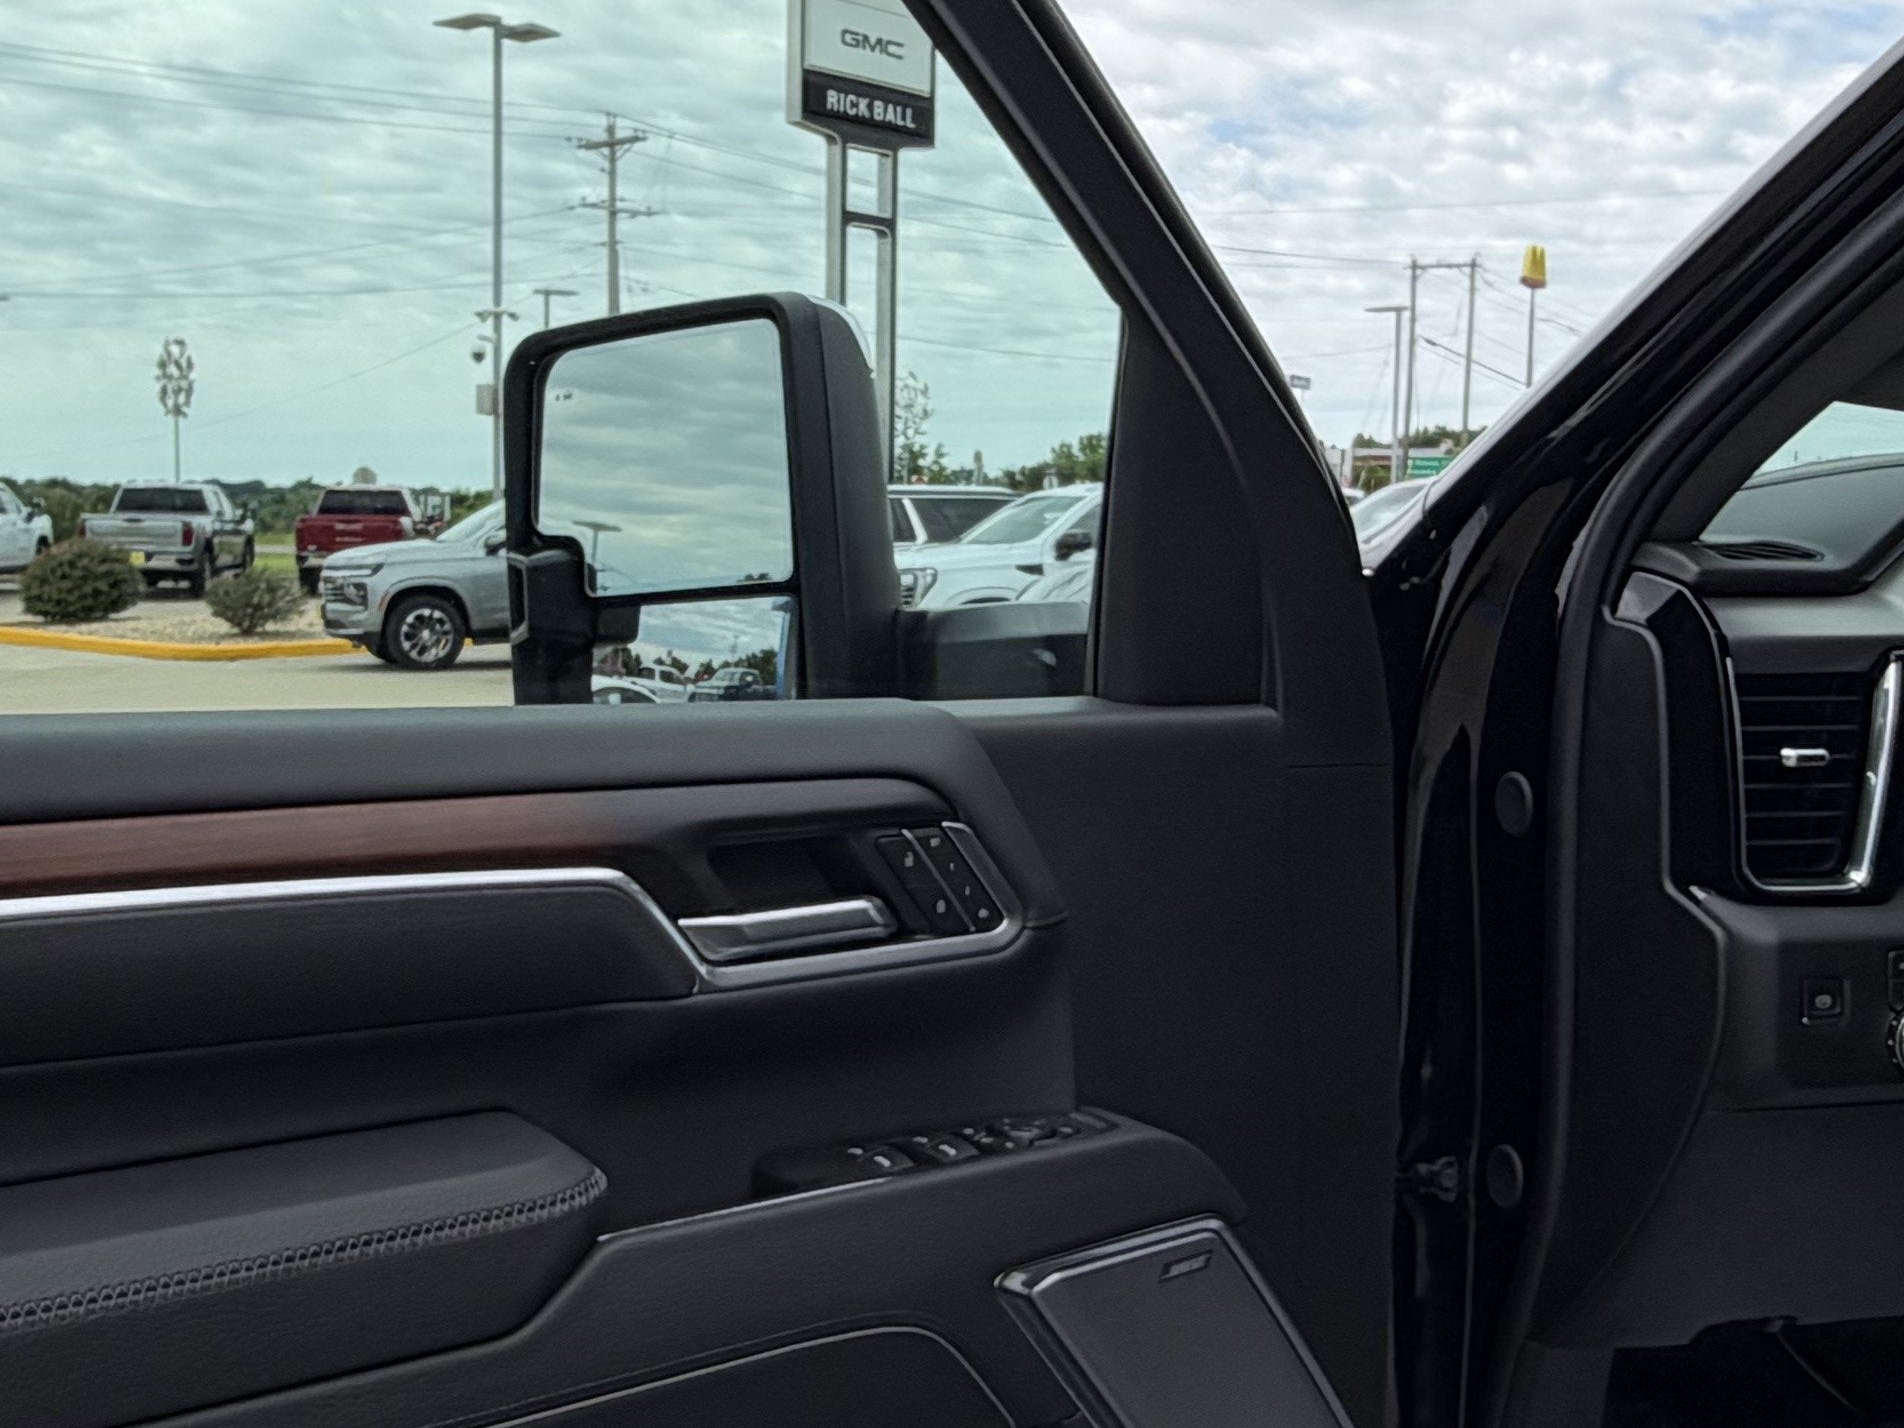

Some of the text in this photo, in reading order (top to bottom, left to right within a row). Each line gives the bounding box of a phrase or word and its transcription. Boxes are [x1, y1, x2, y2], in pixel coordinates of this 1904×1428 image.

[841, 28, 906, 60] GMC
[826, 88, 917, 129] RICK BALL
